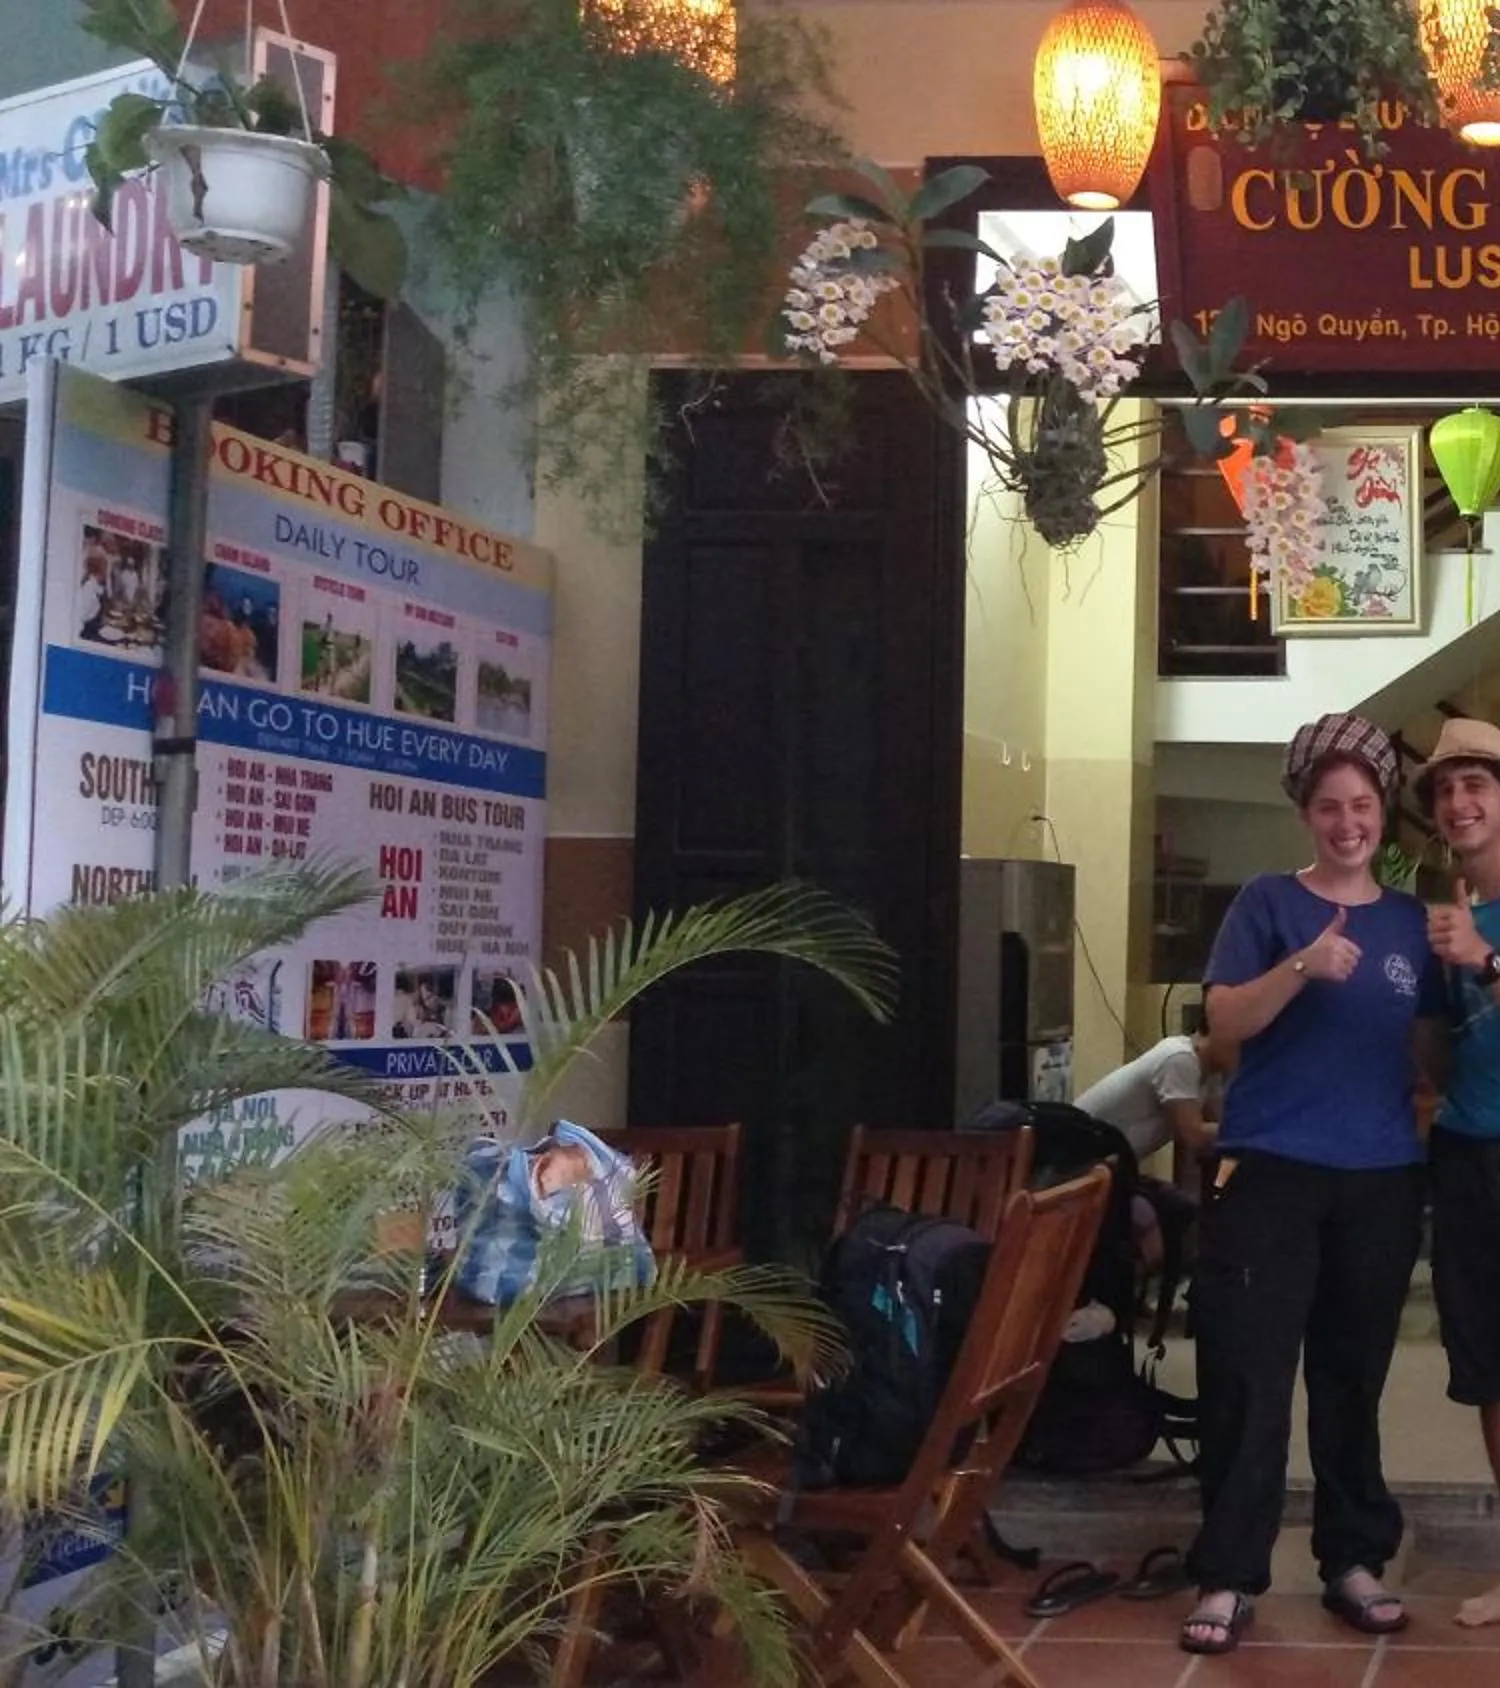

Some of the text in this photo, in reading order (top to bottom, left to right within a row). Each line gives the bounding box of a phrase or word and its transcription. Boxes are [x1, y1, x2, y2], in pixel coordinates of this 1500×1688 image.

[105, 318, 120, 356] 1
[135, 296, 218, 350] USD
[1416, 313, 1456, 341] Tp.
[146, 407, 514, 573] BOKING OFFICE
[274, 513, 423, 587] DAILY TOUR
[197, 688, 239, 721] AN
[248, 698, 293, 732] GO
[301, 708, 339, 742] TO
[346, 719, 396, 752] HUE
[402, 730, 464, 765] EVERY
[470, 743, 510, 774] DAY
[369, 781, 526, 832] HOI AN BUS TOUR
[379, 844, 423, 883] HOI
[381, 884, 418, 921] AN
